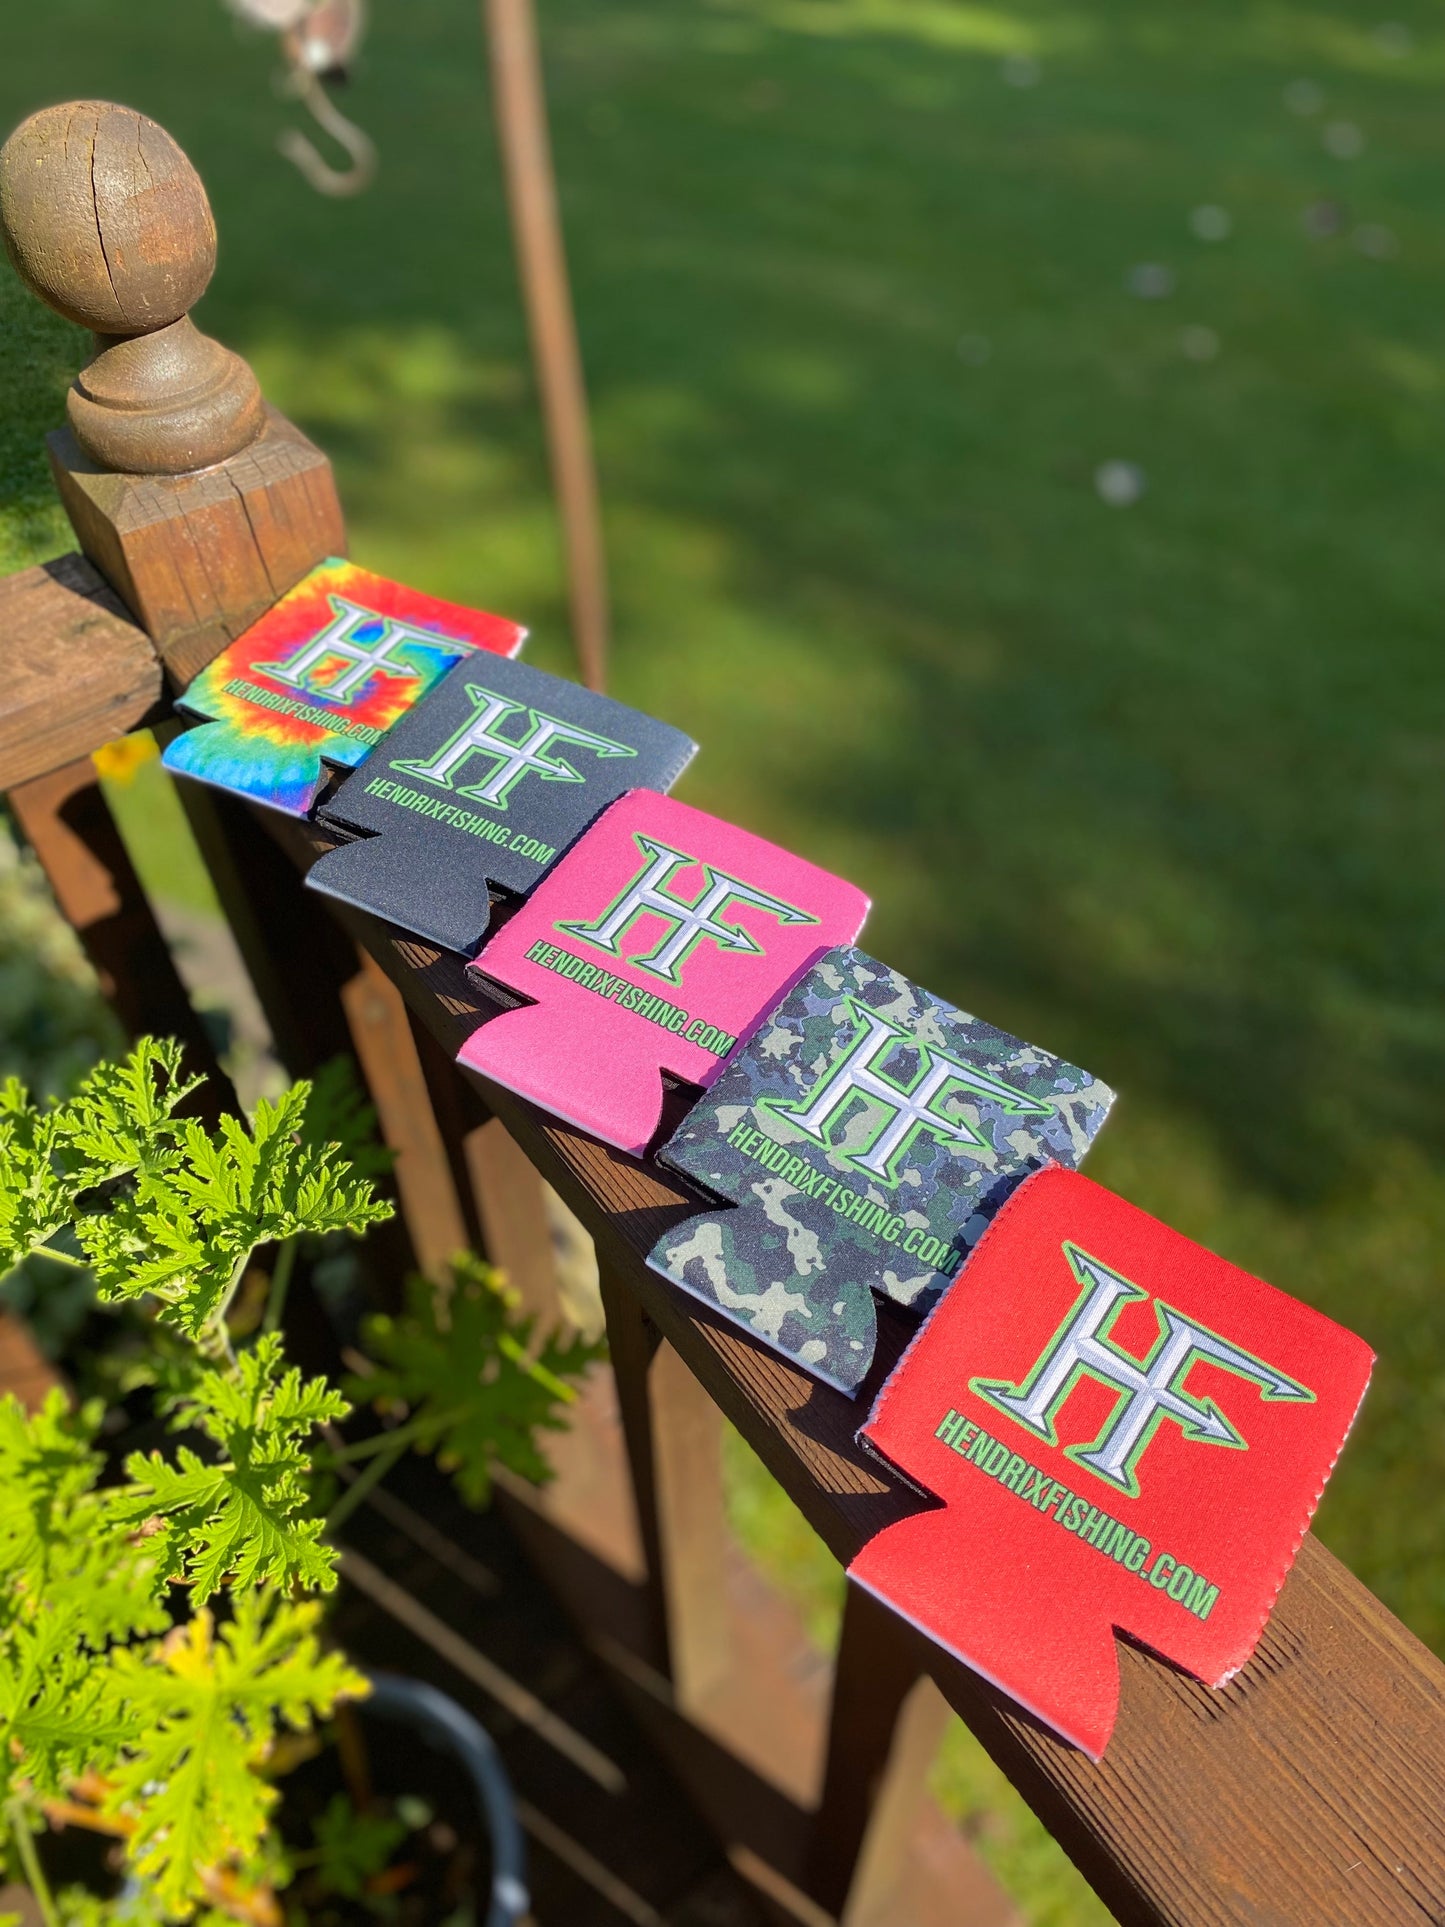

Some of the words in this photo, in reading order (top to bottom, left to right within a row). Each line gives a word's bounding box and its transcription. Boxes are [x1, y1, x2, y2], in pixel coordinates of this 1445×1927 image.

[364, 776, 556, 865] HENDRIXFISHING.COM
[524, 940, 737, 1058] HENDRIXFISHING.COM
[727, 1122, 961, 1274] HENDRIXFISHING.COM
[935, 1409, 1220, 1620] HENDRIXFISHING.COM
